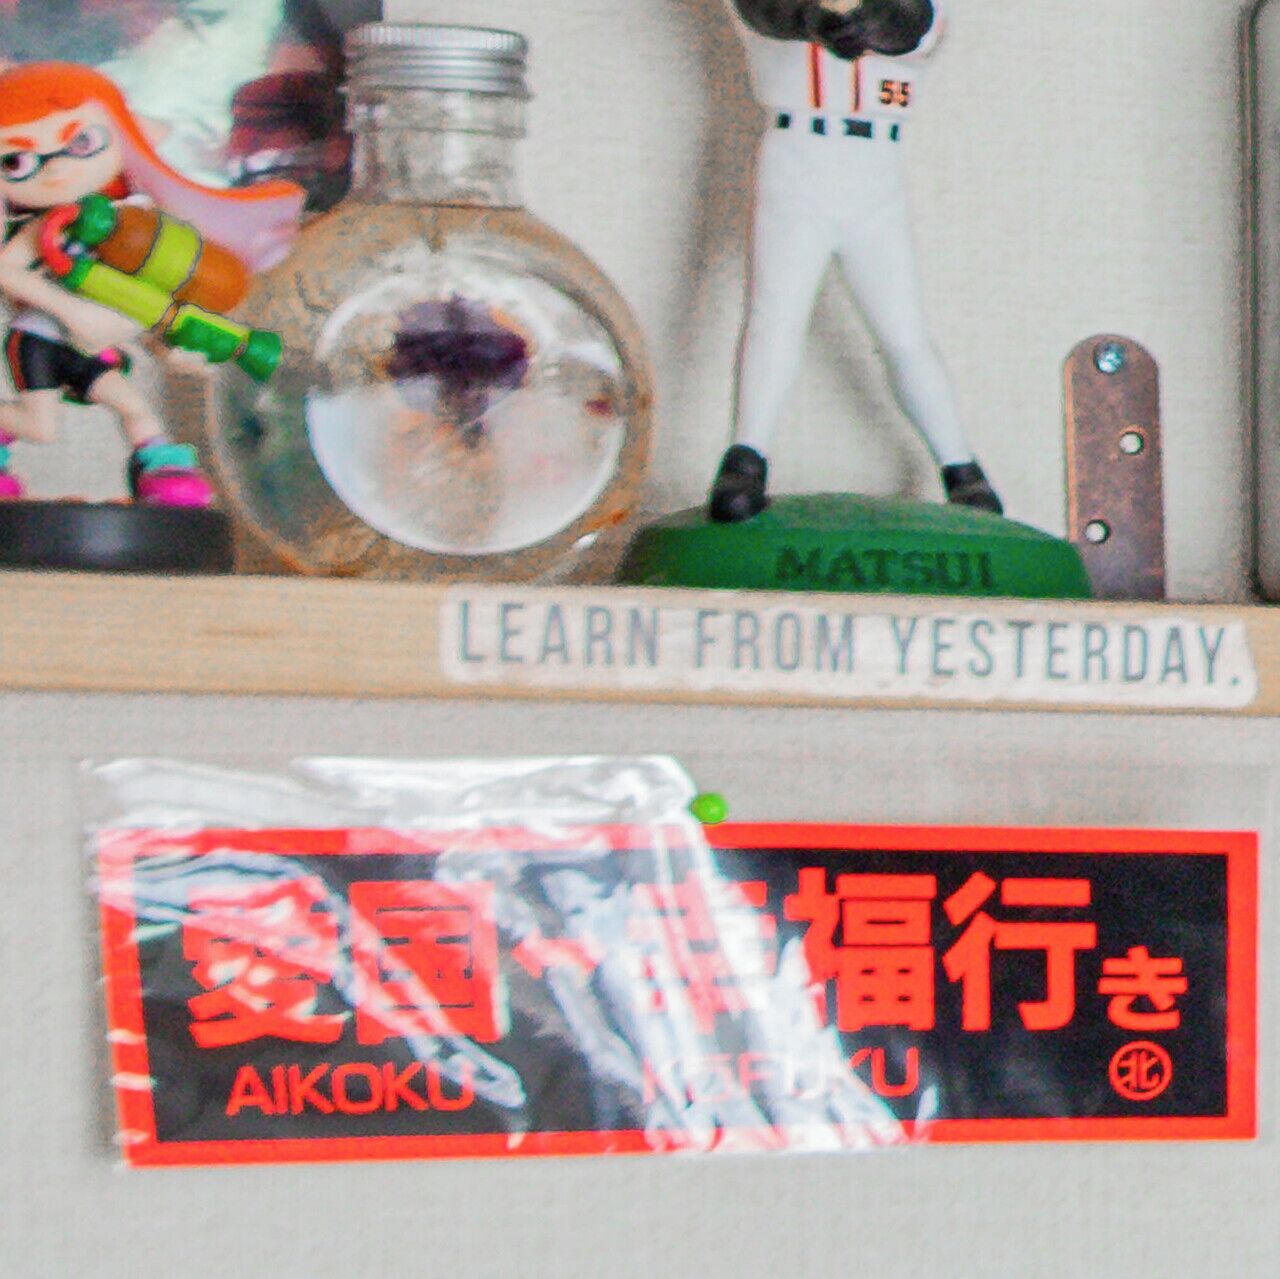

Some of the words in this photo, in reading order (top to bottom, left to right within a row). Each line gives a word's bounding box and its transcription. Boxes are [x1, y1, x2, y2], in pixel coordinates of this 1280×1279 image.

[774, 545, 993, 589] MATSUI
[457, 599, 659, 667] LEARN
[695, 607, 855, 673] FROM
[890, 613, 1240, 686] YESTERDAY.
[225, 1061, 477, 1117] AIKOKU
